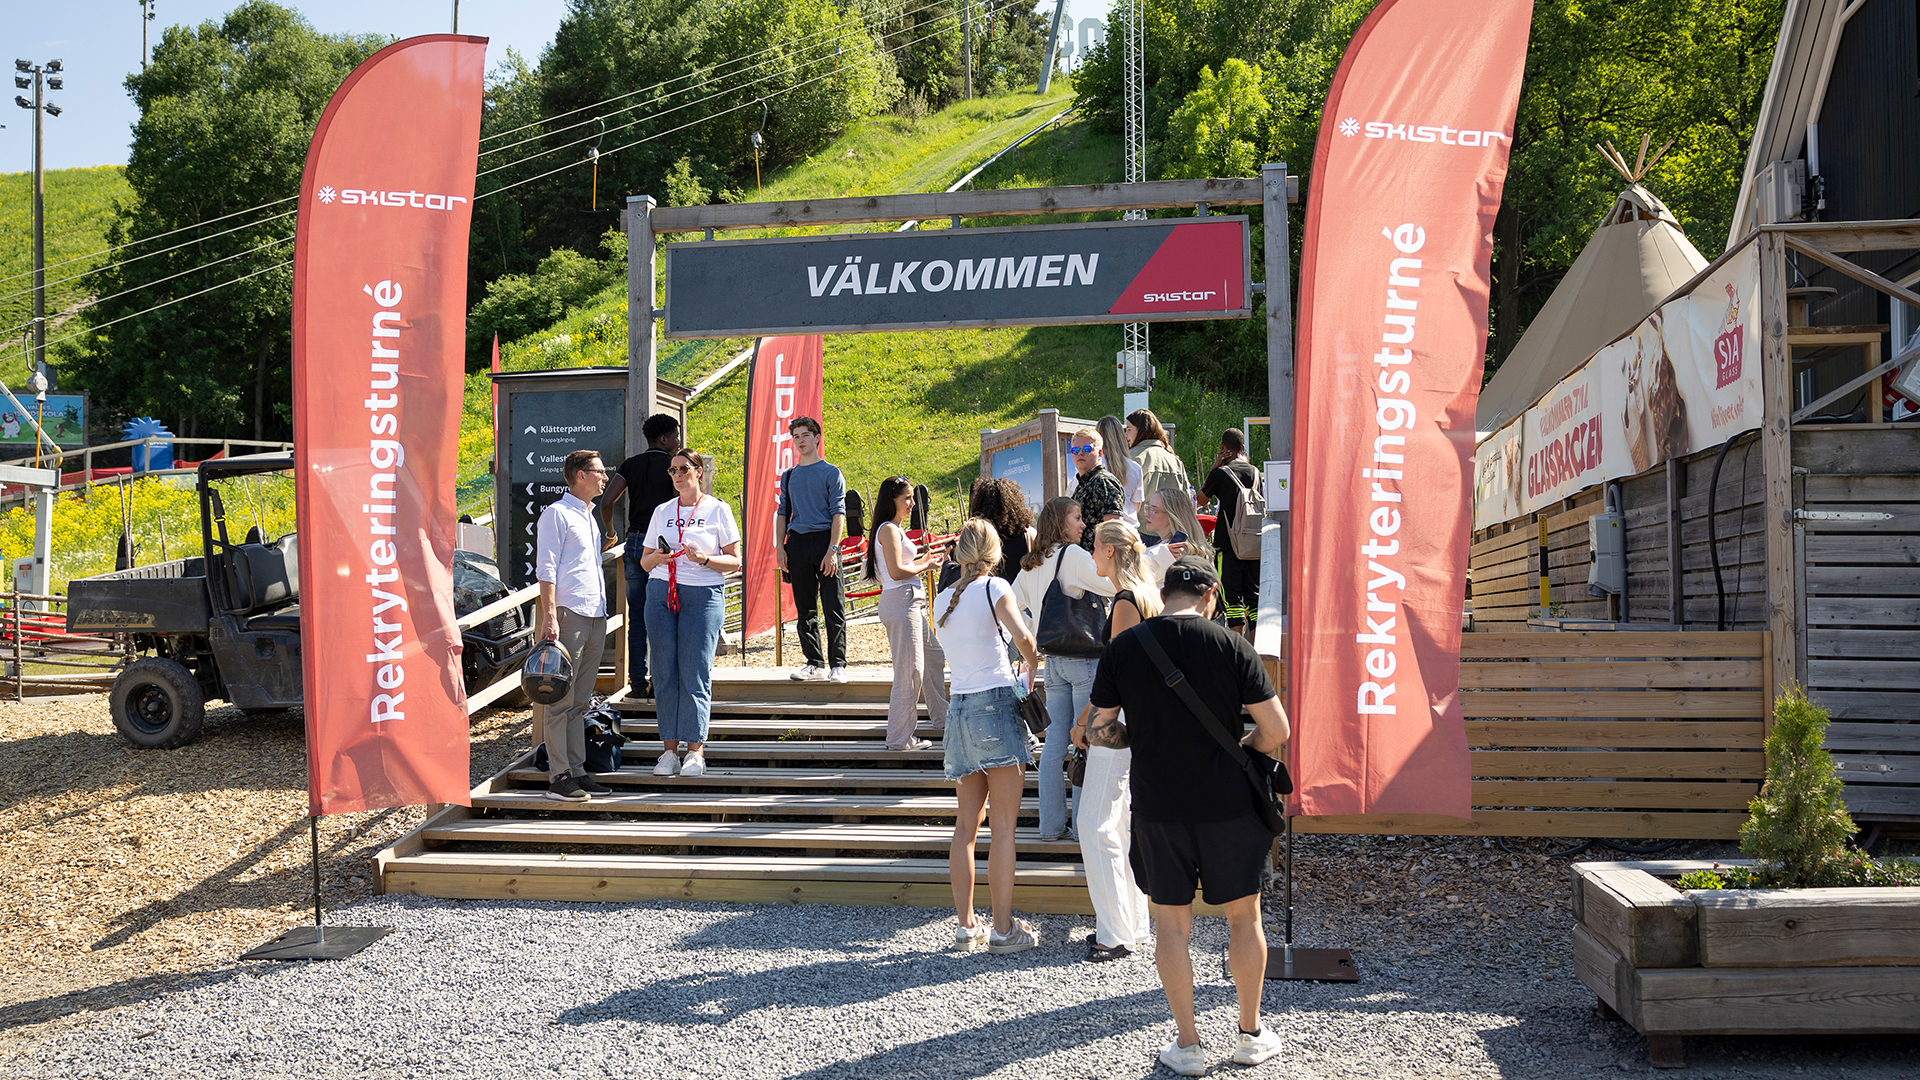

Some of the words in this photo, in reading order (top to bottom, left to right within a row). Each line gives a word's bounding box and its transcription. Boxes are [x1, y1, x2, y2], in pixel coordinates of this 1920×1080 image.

[807, 253, 1100, 298] VÄLKOMMEN
[1718, 334, 1739, 370] SIA
[1722, 365, 1738, 381] GLASS
[540, 424, 597, 435] Klätterparken
[1540, 394, 1573, 438] VÄLKOMMEN
[1572, 383, 1589, 415] TILL
[1356, 222, 1426, 716] Rekryteringsturné
[1527, 411, 1603, 499] GLASSBACKEN
[361, 279, 408, 723] Rekryteringsturné
[666, 518, 705, 528] EQPE
